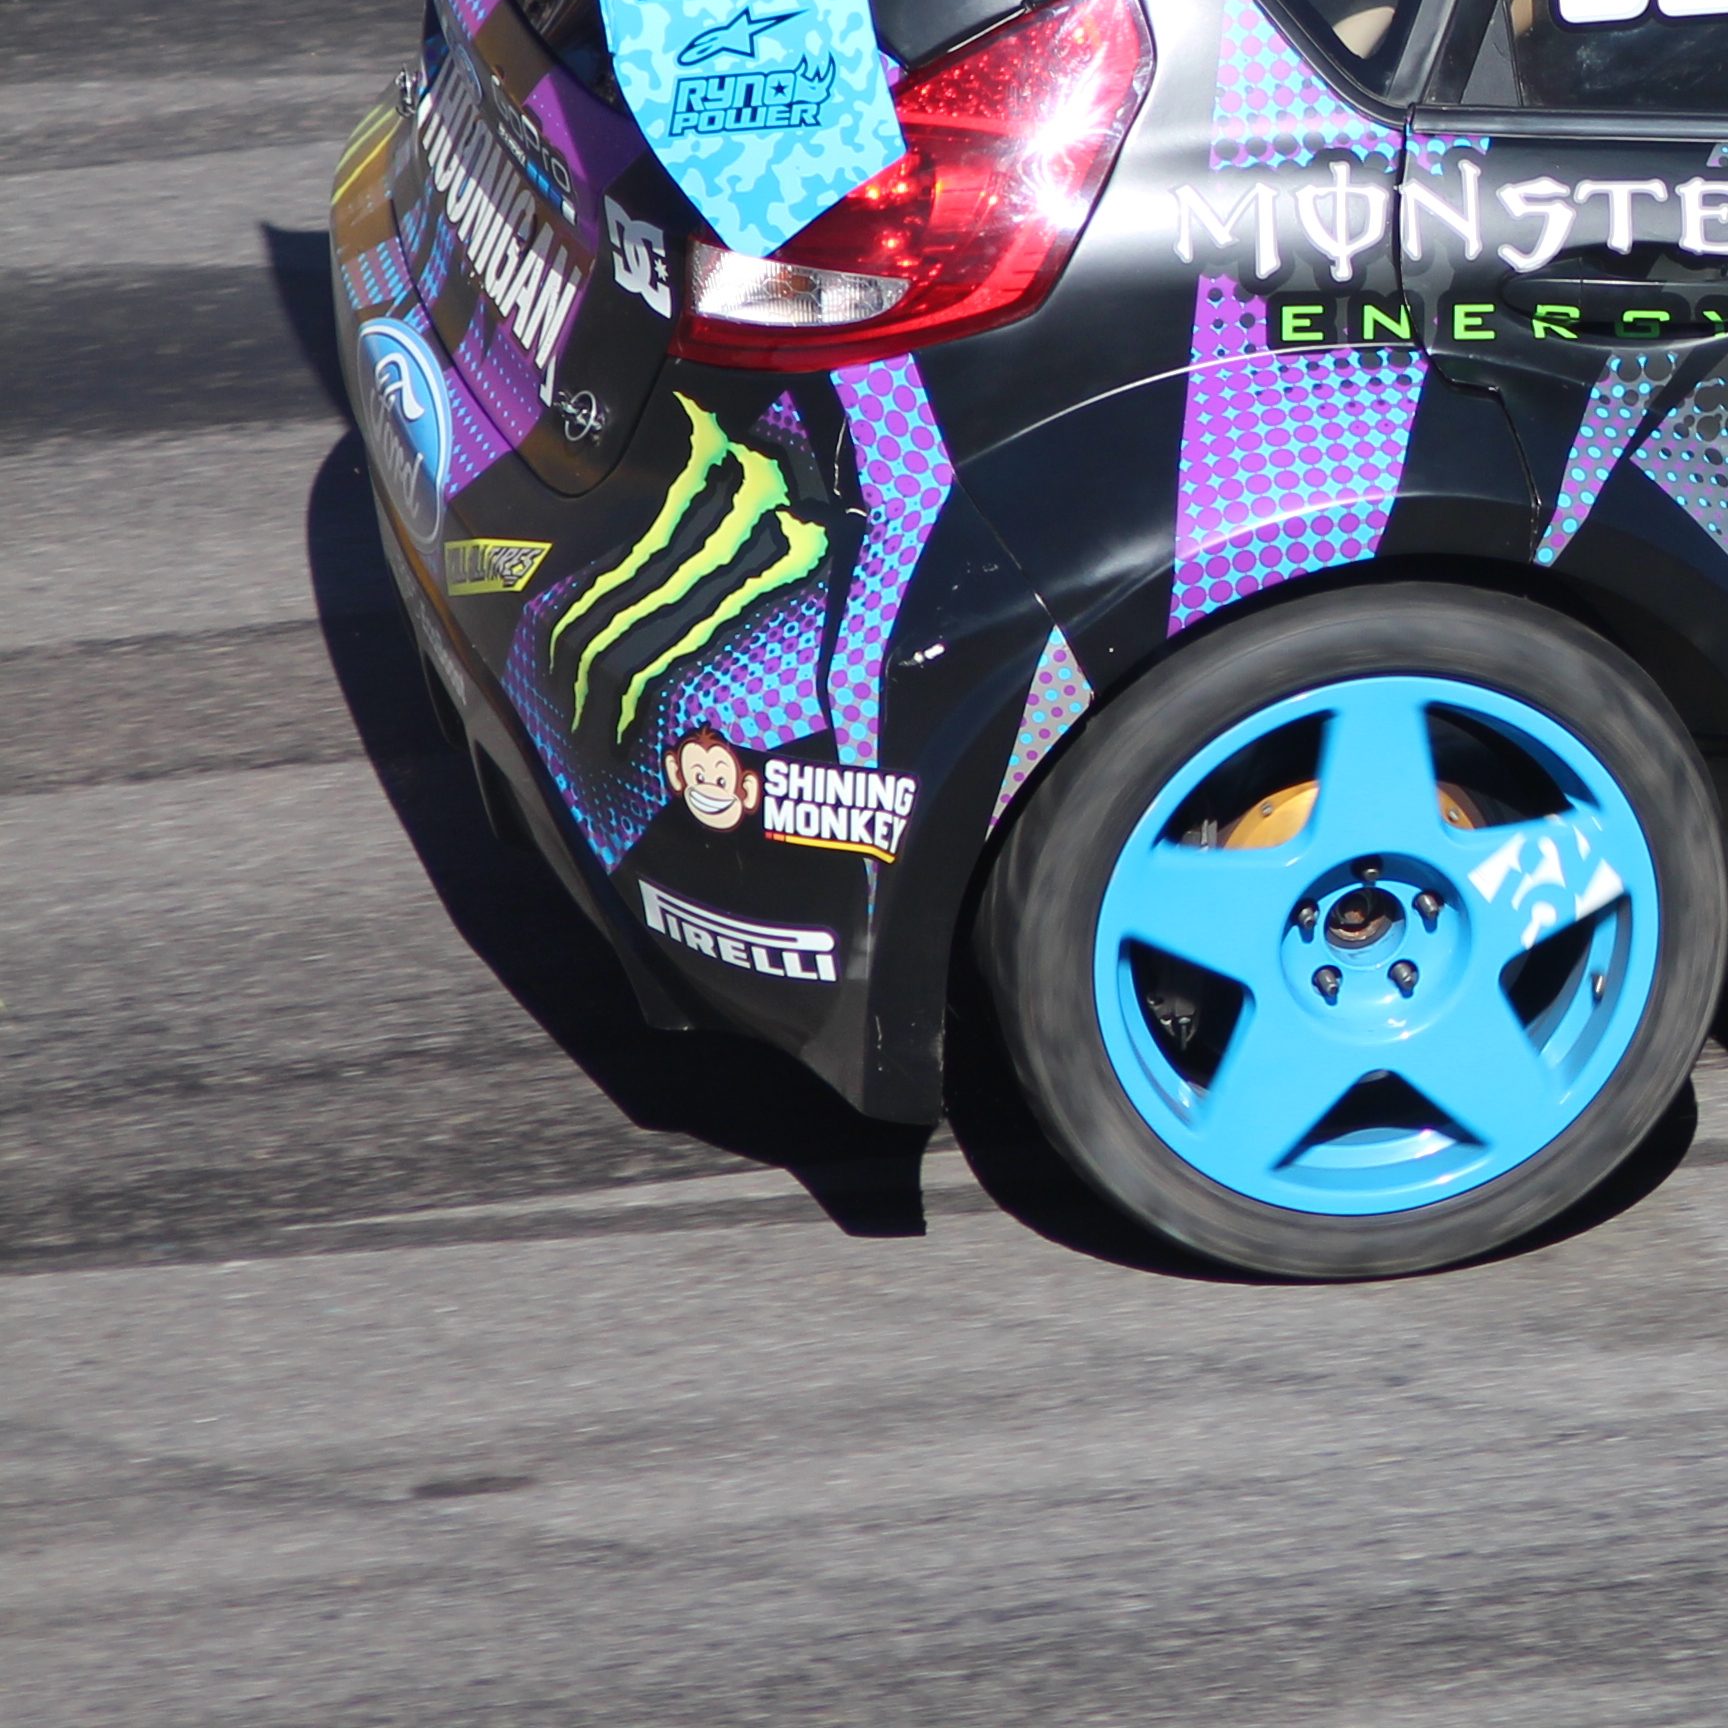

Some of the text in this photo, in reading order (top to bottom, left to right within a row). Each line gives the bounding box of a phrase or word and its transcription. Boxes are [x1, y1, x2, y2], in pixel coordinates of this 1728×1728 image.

[670, 101, 822, 137] POWER
[764, 759, 917, 817] SHINING
[764, 795, 907, 854] MONKEY
[638, 879, 838, 982] PIRELLI
